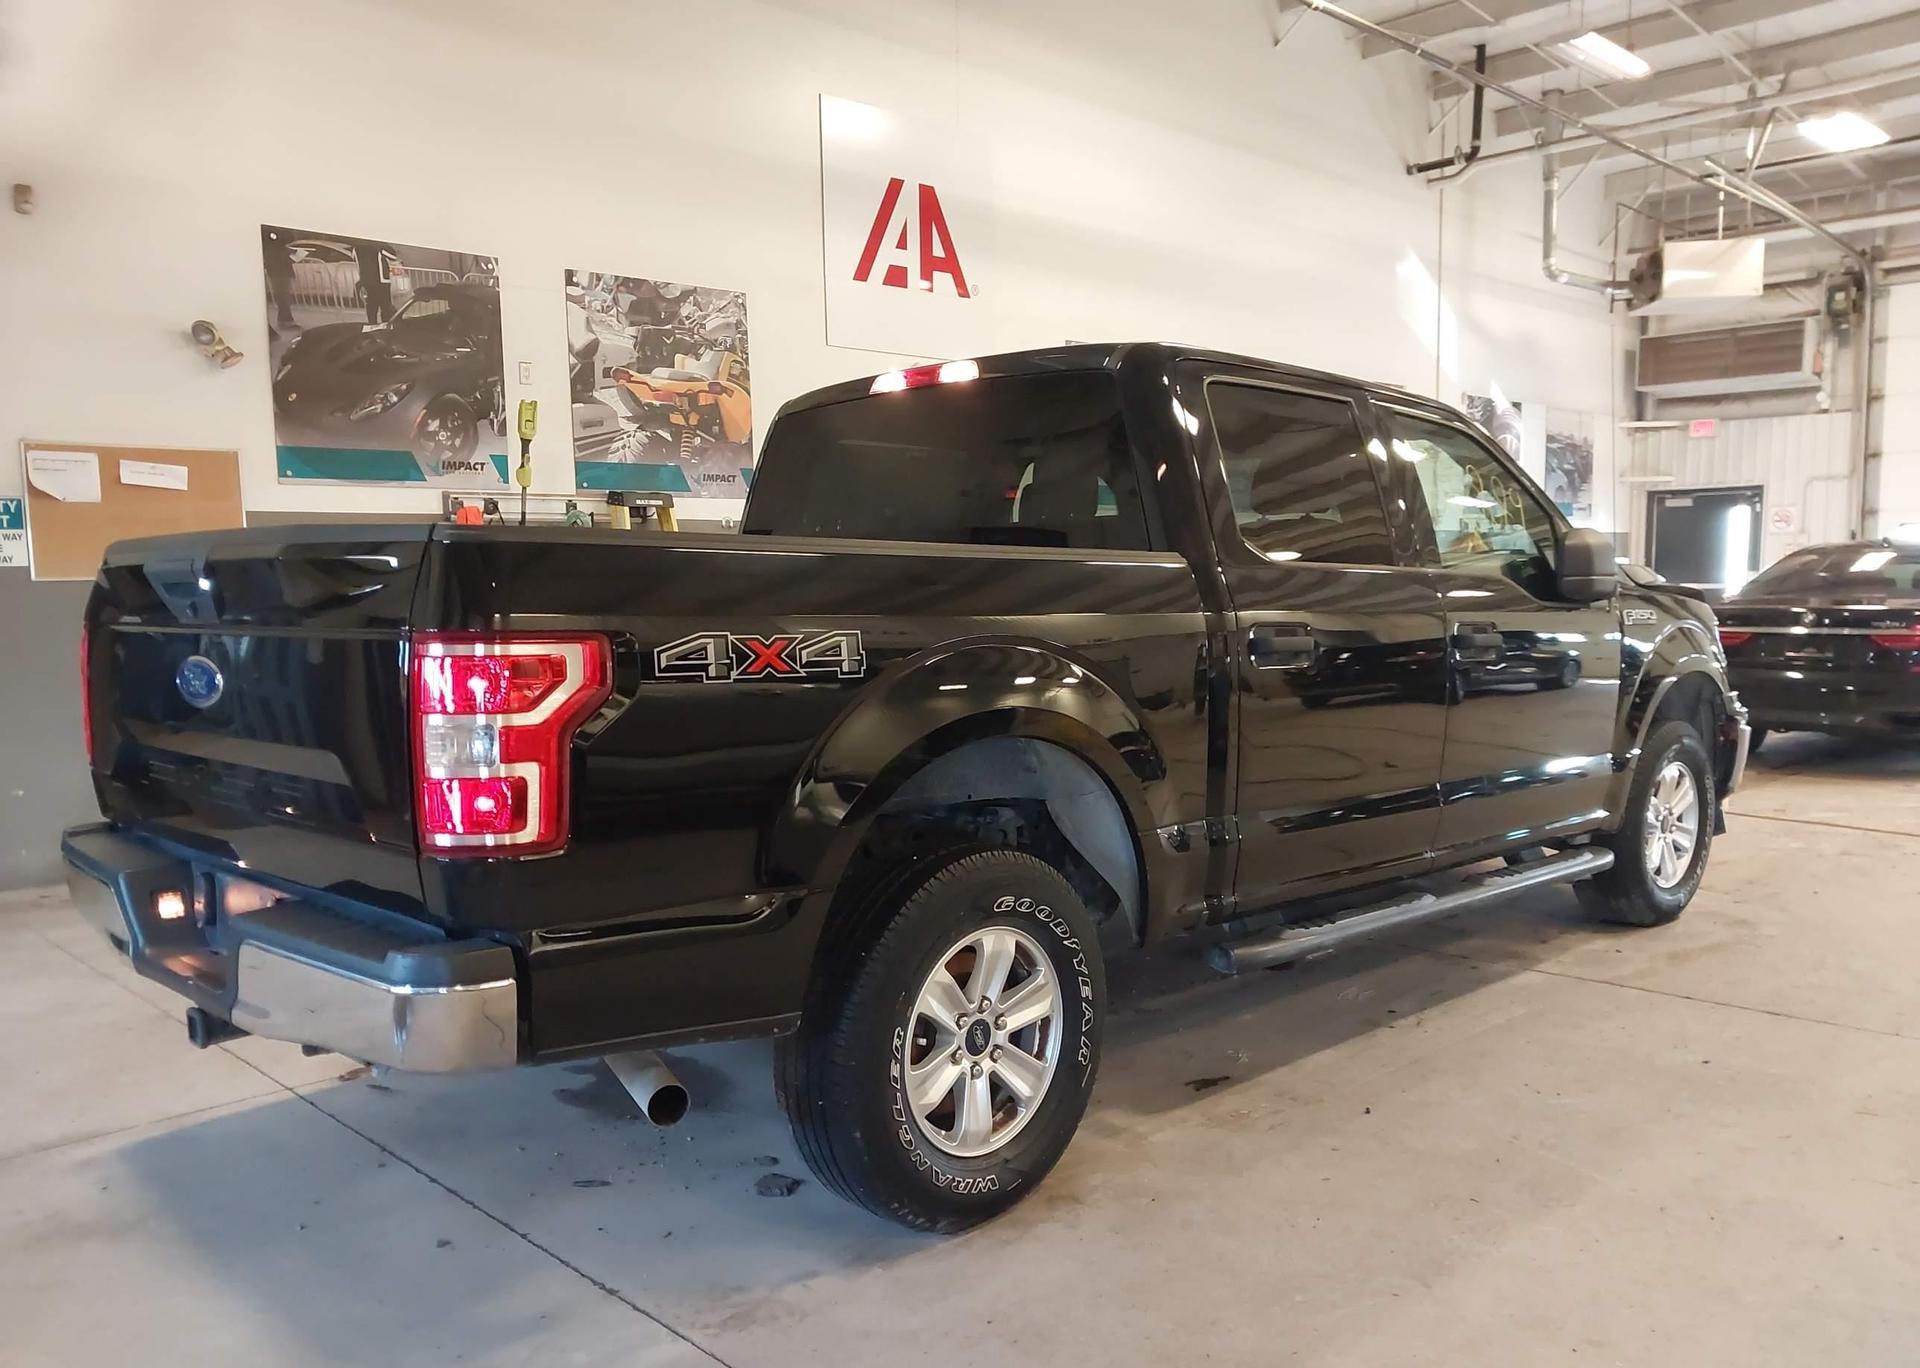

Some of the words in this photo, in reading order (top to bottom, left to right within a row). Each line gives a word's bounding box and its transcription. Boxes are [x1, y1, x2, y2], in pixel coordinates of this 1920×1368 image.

[441, 461, 486, 471] IMPACT
[703, 474, 737, 483] IMPACT
[2, 533, 23, 541] WAY
[0, 555, 13, 563] AY
[993, 896, 1095, 1065] GOODYEAR
[890, 1027, 1000, 1193] WRANGLER
